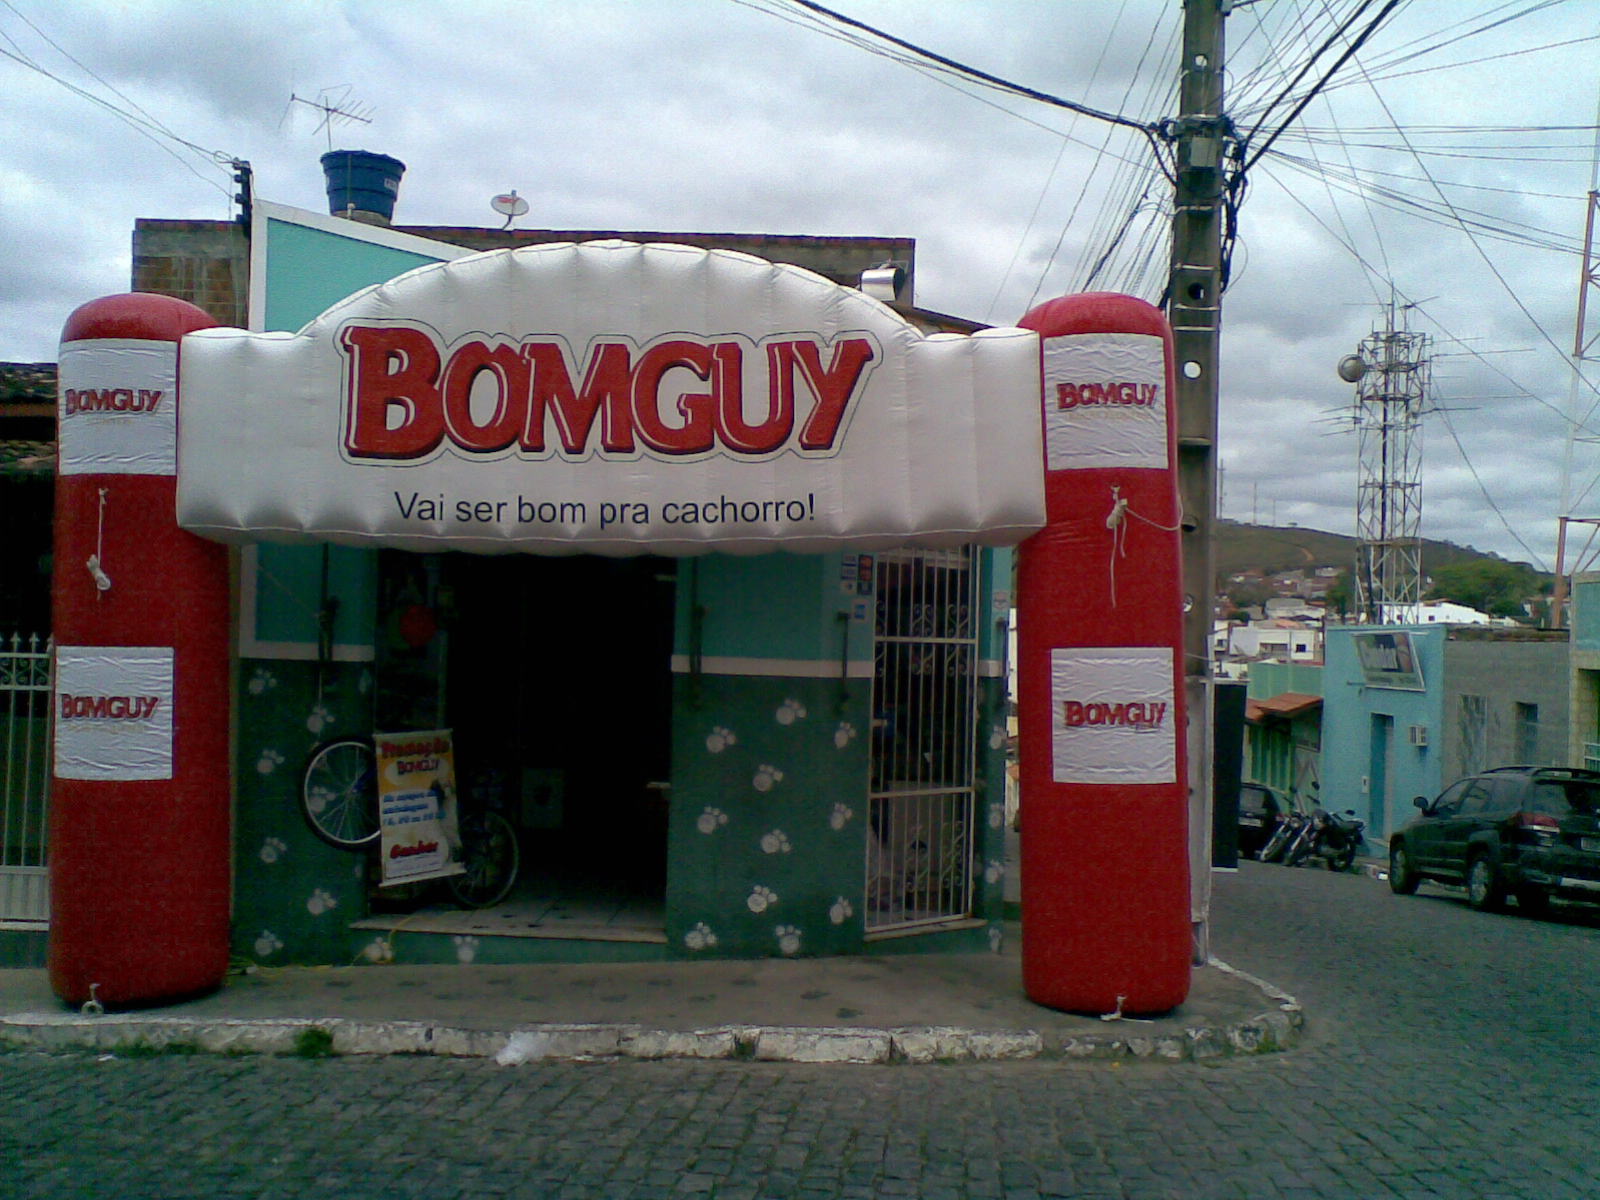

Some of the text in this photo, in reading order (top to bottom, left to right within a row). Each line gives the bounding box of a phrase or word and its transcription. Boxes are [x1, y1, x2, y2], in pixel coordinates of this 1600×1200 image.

[65, 388, 162, 415] BOMGUY
[341, 325, 875, 460] BOMGUY
[1056, 382, 1159, 409] BOMGUY
[394, 491, 816, 530] Vai ser bom pra cachorro!
[61, 693, 159, 719] BOMGUY
[1063, 701, 1167, 728] BOMGUY
